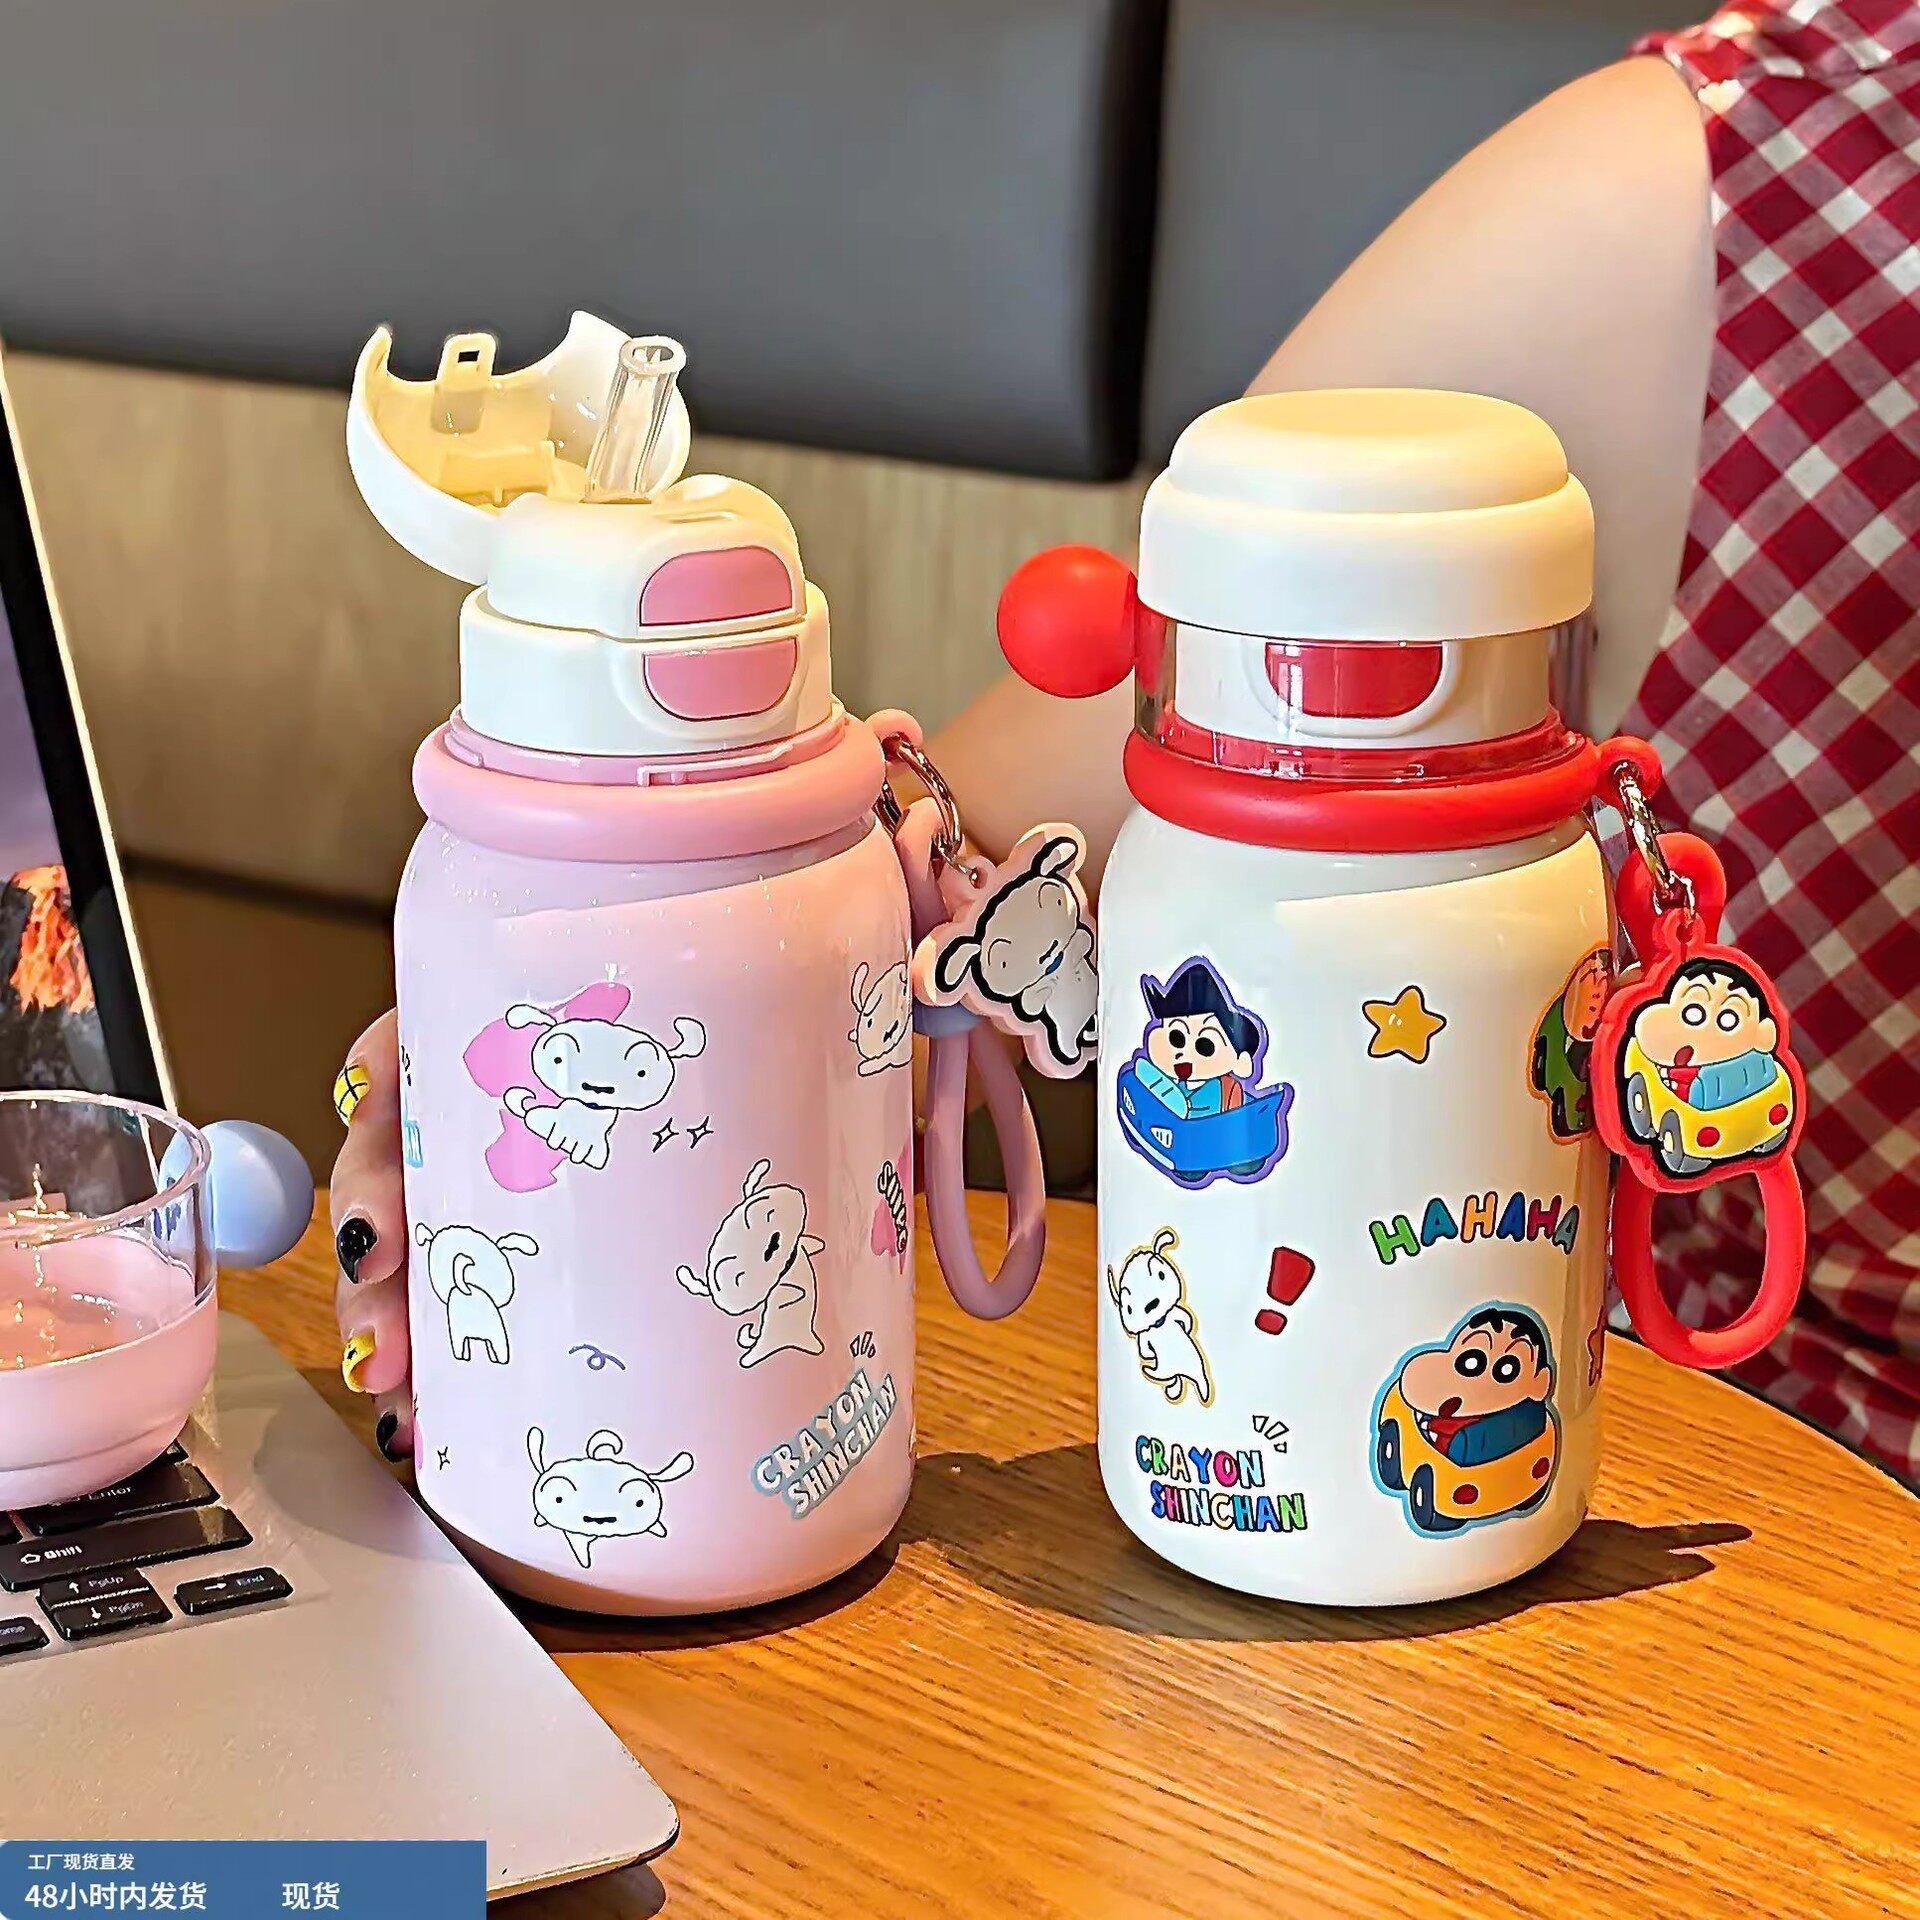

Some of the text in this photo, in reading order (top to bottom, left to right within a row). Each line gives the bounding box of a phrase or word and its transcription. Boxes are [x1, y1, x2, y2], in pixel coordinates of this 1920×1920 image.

[1369, 1191, 1580, 1265] HAHAHA
[755, 1368, 872, 1490] CRAYON
[787, 1373, 898, 1514] SHINCHAN
[1135, 1434, 1265, 1489] CRAYON
[1150, 1480, 1308, 1532] SHINCHAN
